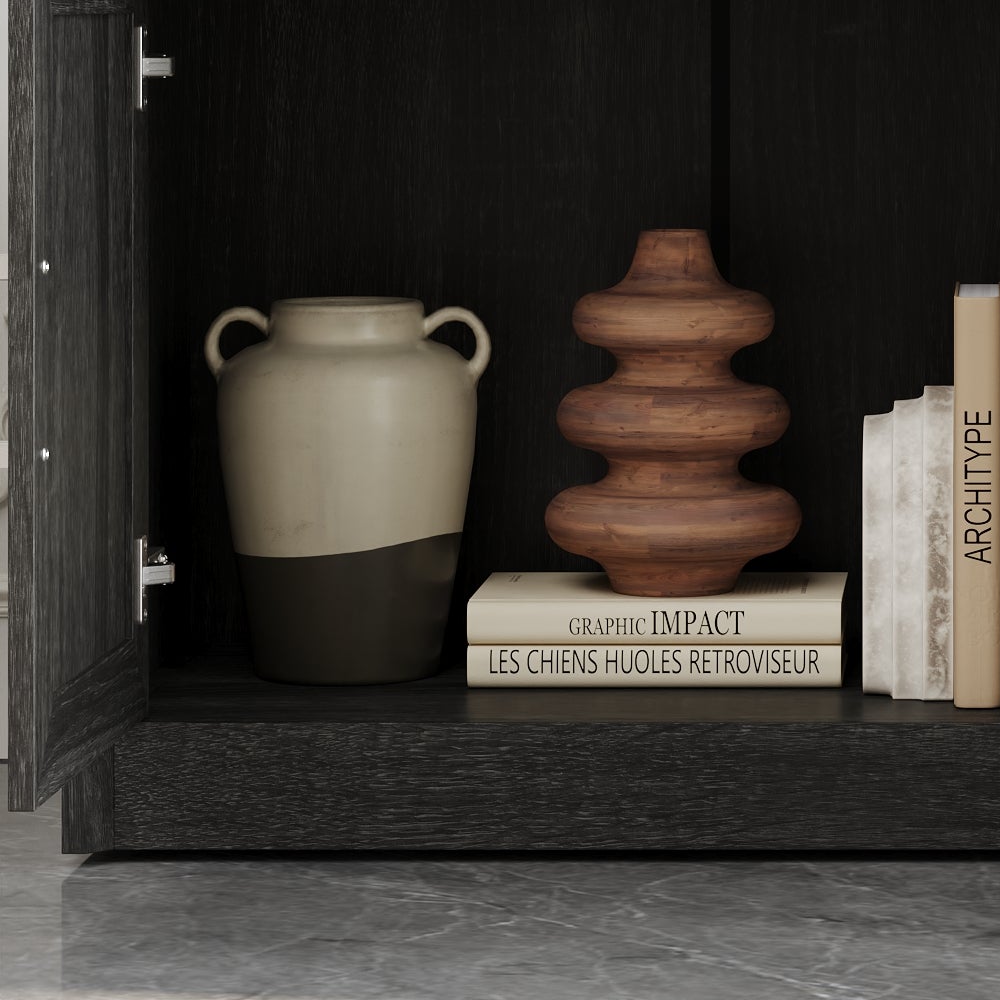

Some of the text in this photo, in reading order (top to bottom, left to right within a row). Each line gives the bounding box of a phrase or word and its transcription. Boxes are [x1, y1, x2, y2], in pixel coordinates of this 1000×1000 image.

[964, 410, 992, 565] ARCHITYPE
[568, 610, 745, 636] GRAPHIC IMPACT
[489, 649, 820, 675] LES CHIENS HUOLES RETROVISEUR
